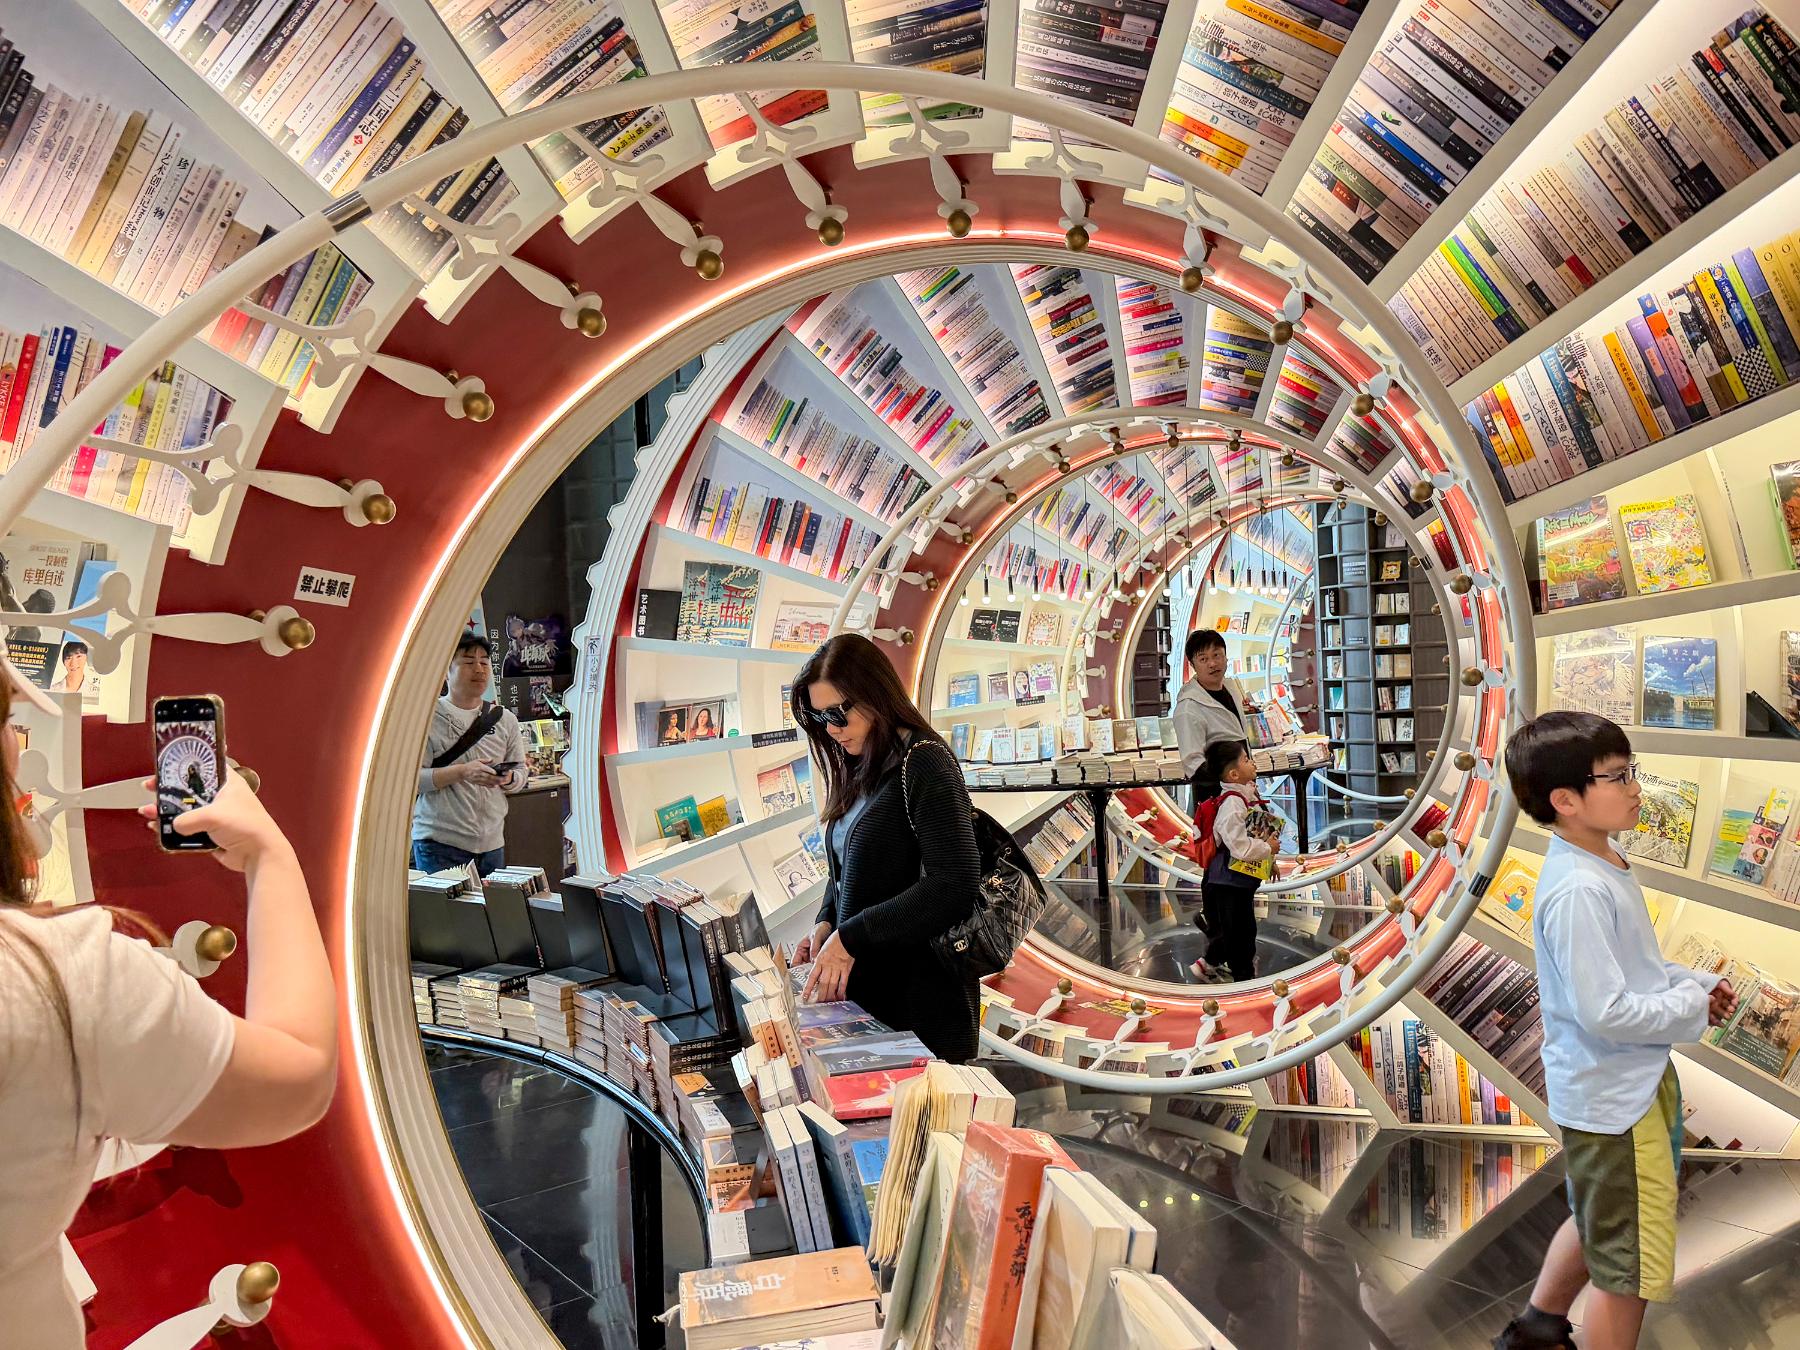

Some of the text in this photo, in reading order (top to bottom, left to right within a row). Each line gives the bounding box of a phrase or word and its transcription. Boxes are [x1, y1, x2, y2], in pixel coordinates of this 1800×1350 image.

[1206, 21, 1225, 38] Little
[1265, 105, 1287, 117] JOHN
[177, 157, 190, 170] 珍
[140, 152, 173, 209] 艺术创世记
[152, 207, 165, 220] 物
[1572, 338, 1588, 359] Little
[23, 568, 65, 587] 库里自述
[300, 573, 351, 599] 禁止攀爬
[638, 593, 649, 637] 艺术图书
